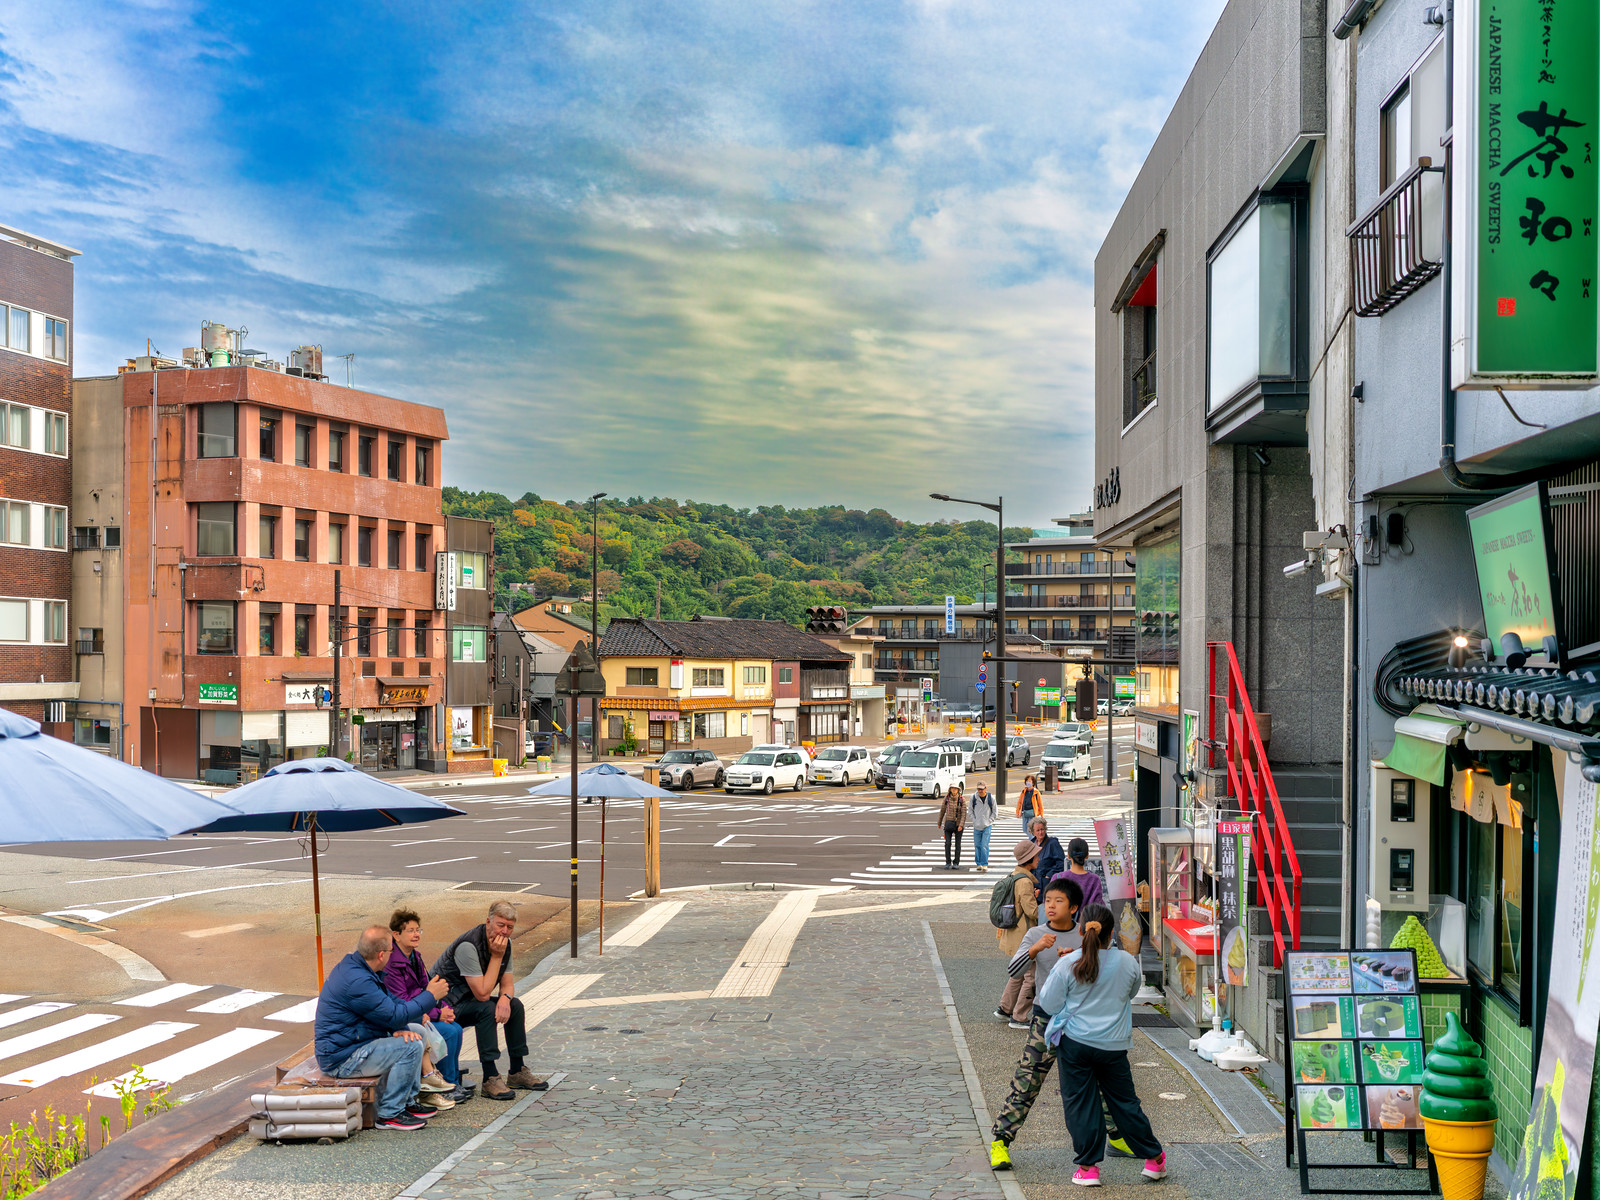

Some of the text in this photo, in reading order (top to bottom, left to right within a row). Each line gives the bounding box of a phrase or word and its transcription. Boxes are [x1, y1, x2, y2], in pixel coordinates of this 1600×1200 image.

[1489, 103, 1502, 171] MACCHA
[1500, 100, 1587, 302] 茶和々
[1222, 823, 1251, 834] 自家製
[1102, 841, 1124, 876] 金箔
